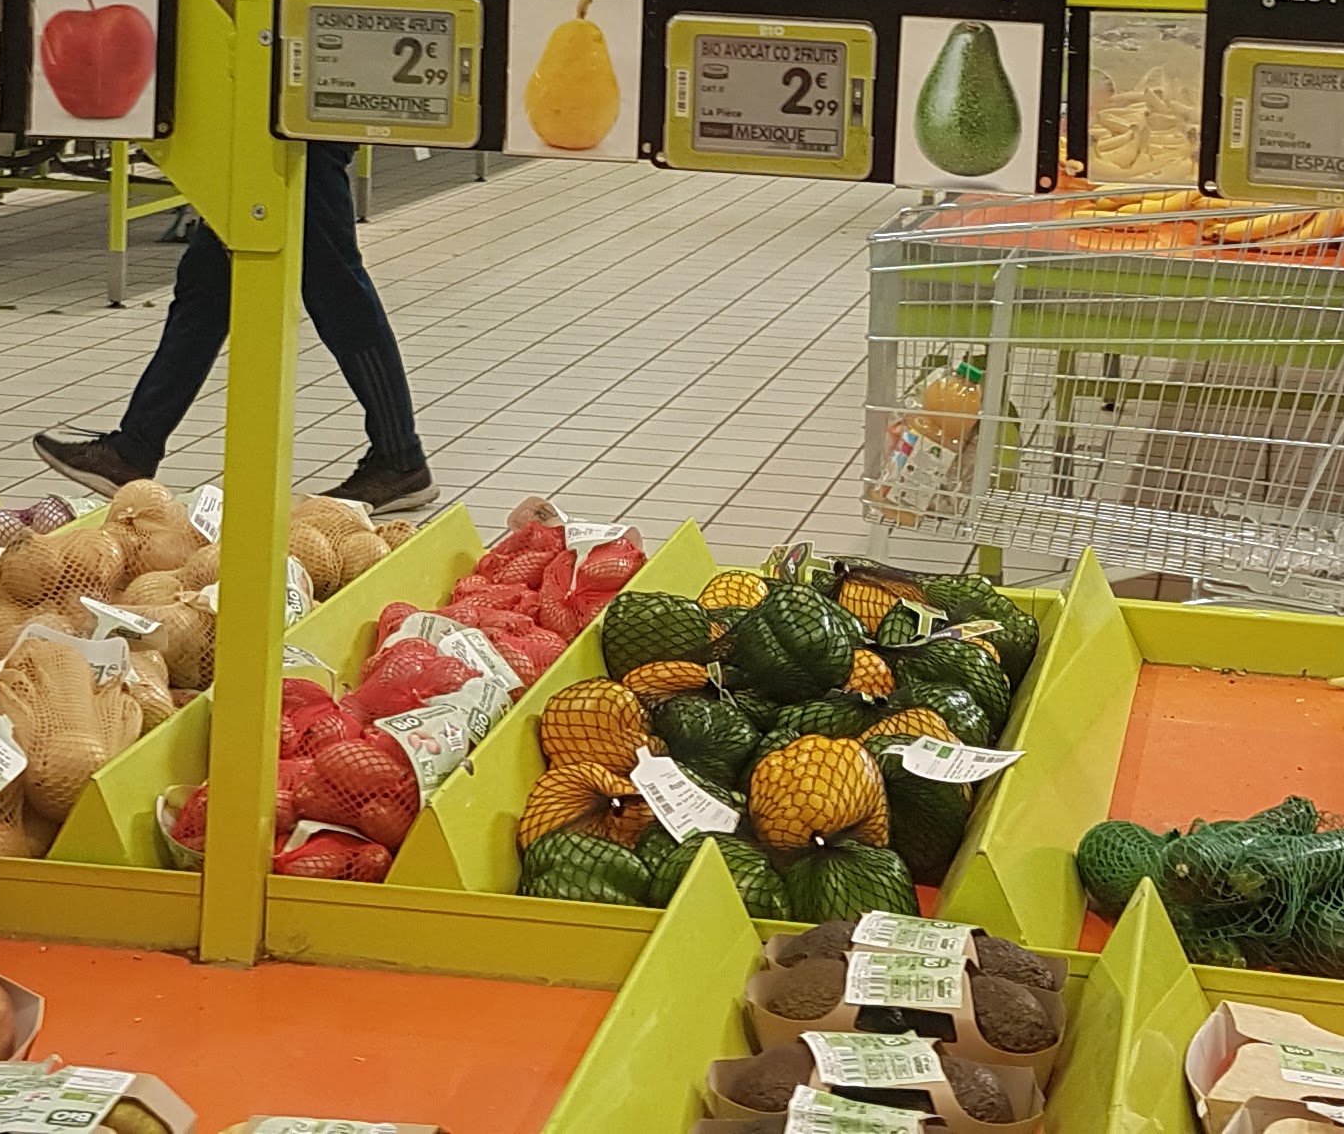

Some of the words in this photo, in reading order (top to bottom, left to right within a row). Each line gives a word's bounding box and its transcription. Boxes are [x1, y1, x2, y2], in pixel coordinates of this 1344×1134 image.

[316, 13, 355, 29] CASINO
[701, 42, 722, 56] BIO
[725, 44, 770, 59] AVOCAT
[794, 47, 839, 63] 2FRUITS
[1260, 70, 1301, 87] TOMATE
[1302, 72, 1339, 90] GRAPPE
[347, 95, 431, 112] ARGENTINE
[701, 107, 714, 116] La
[735, 125, 806, 142] MEXIQUE
